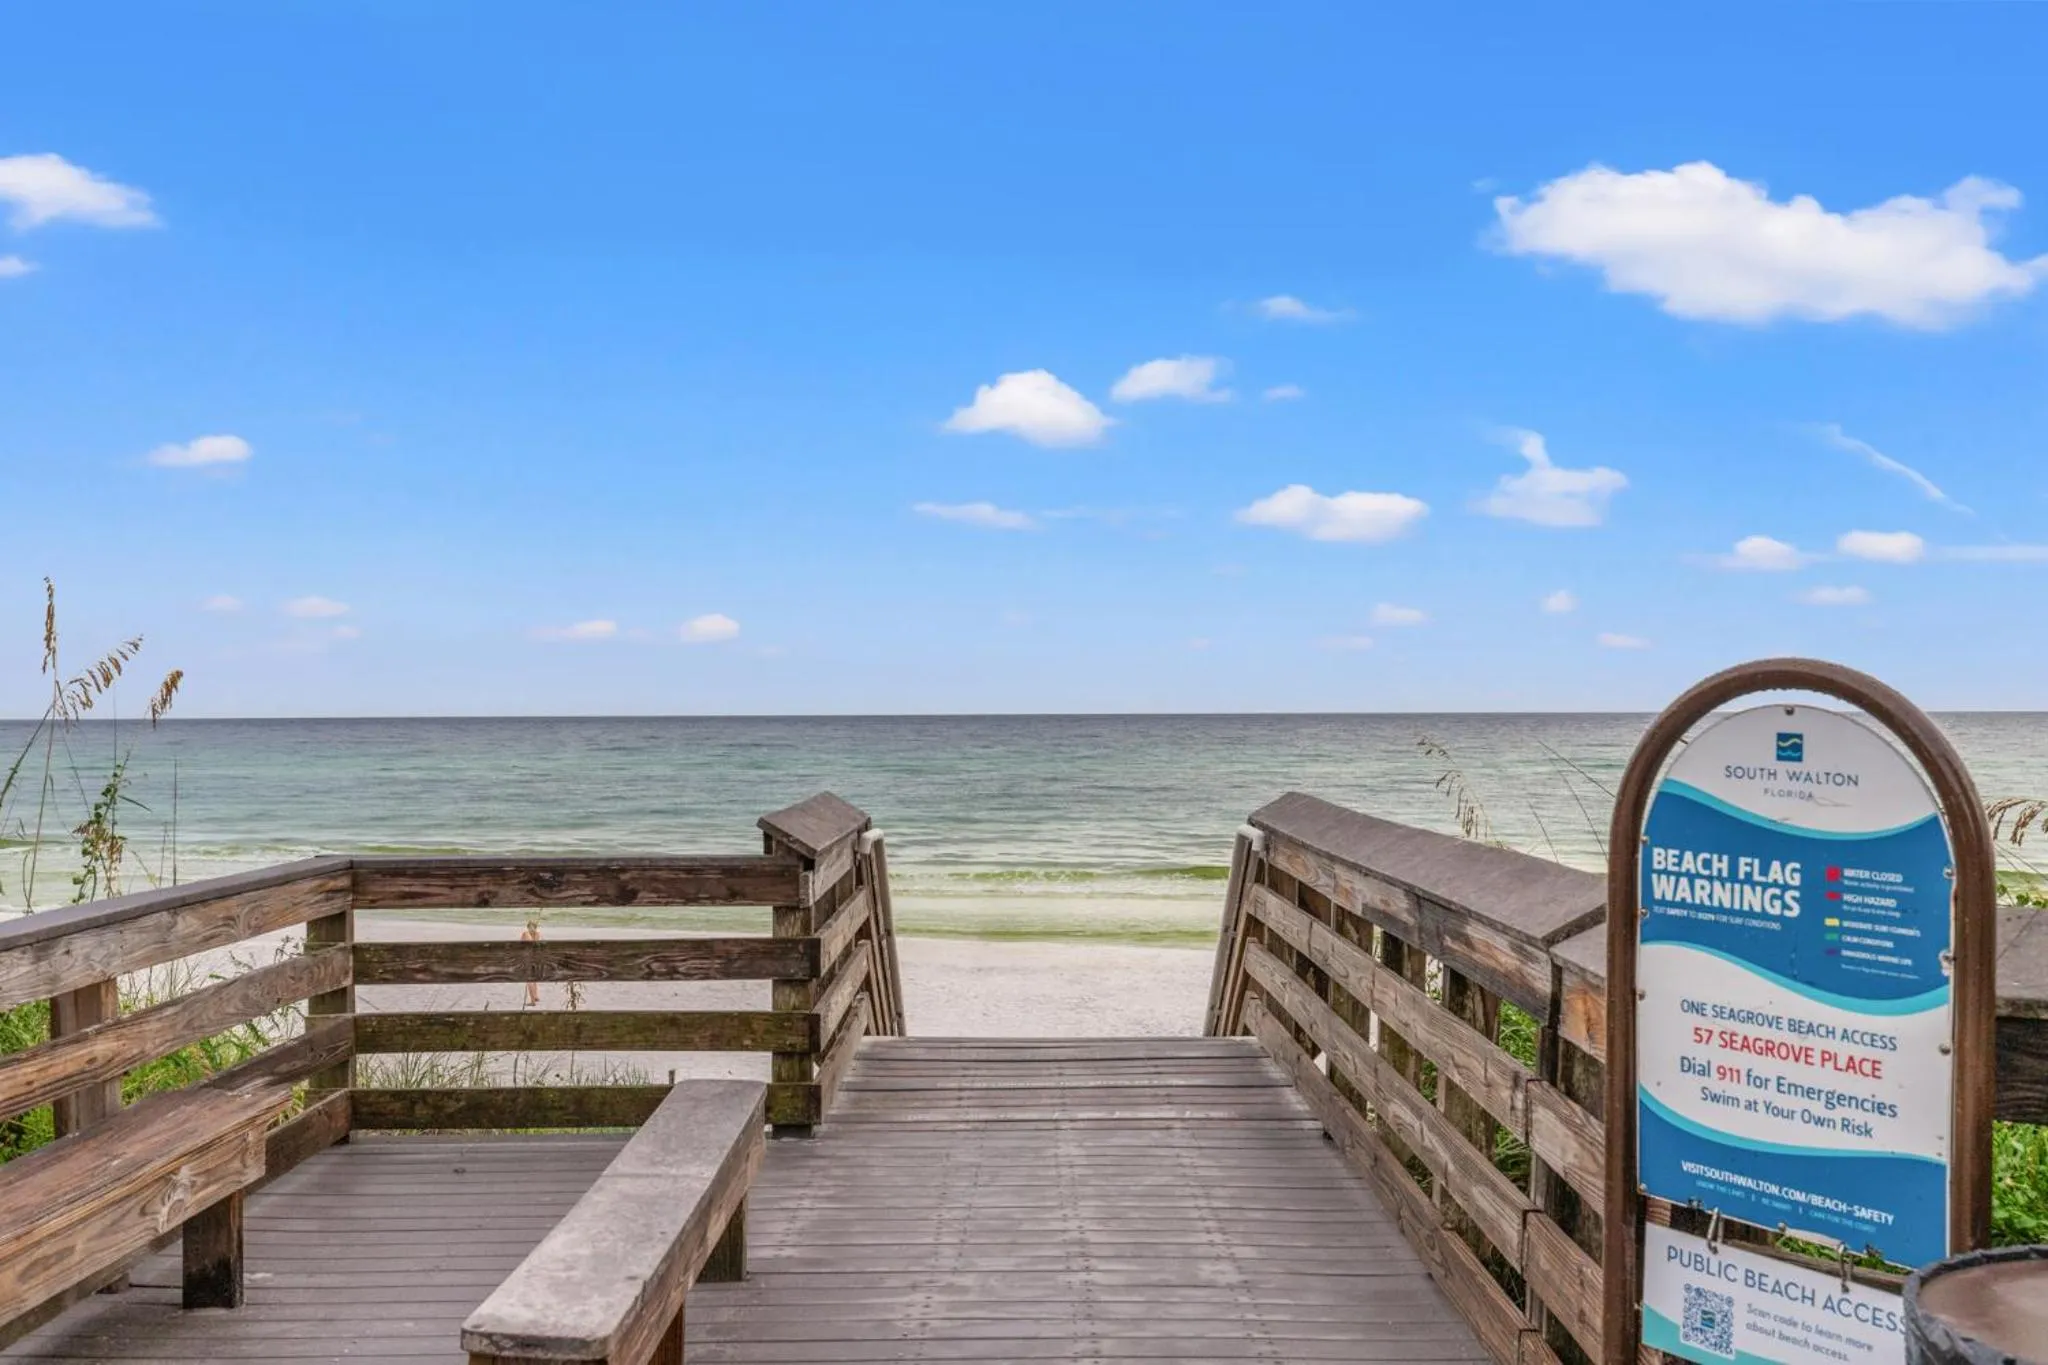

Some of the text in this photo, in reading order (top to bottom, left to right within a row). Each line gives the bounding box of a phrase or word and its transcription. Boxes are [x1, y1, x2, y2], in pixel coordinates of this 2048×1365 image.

[1724, 765, 1860, 787] SOUTH WALTON
[1763, 788, 1815, 802] FLORIDA
[1652, 847, 1802, 887] BEACH FLAG
[1652, 873, 1801, 918] WARNINGS
[1680, 998, 1898, 1052] ONE SEAGROVE BEACH ACCESS
[1693, 1027, 1884, 1080] 57 SEAGROVE PLACE
[1680, 1055, 1898, 1118] Dial 911 for Emergencies
[1700, 1086, 1874, 1139] Swim at Your Own Risk
[1681, 1160, 1895, 1226] VISITSOUTHWALTON.COM/BEACH-SAFETY
[1666, 1245, 1738, 1283] PUBLIC
[1744, 1267, 1816, 1307] BEACH
[1745, 1320, 1850, 1362] about beach access.
[1746, 1303, 1874, 1352] Scan code to learn more
